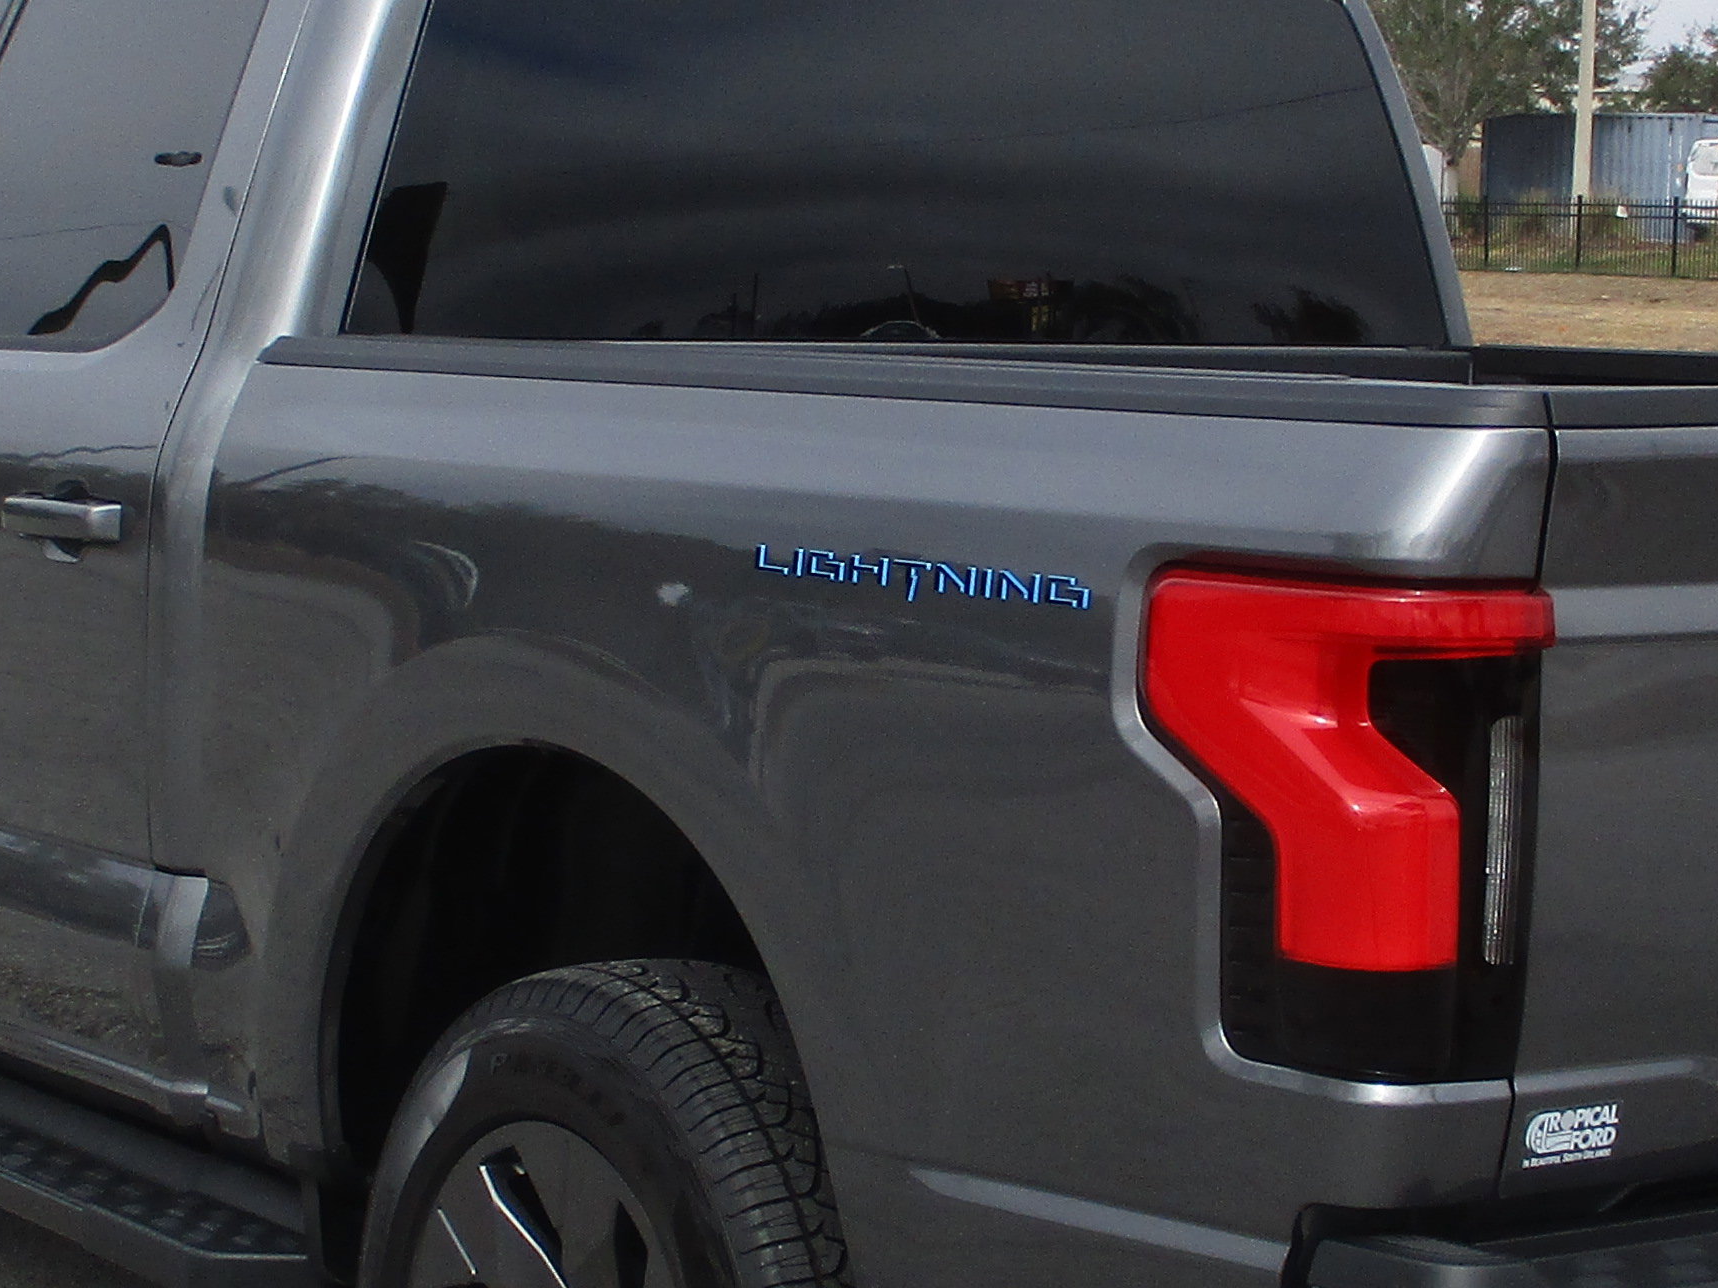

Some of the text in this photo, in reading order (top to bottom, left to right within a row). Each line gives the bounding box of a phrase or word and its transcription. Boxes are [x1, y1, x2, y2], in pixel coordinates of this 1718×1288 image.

[755, 542, 1091, 610] LIGHTNING
[1543, 1103, 1620, 1133] TROPICAL
[1570, 1127, 1617, 1150] FORD
